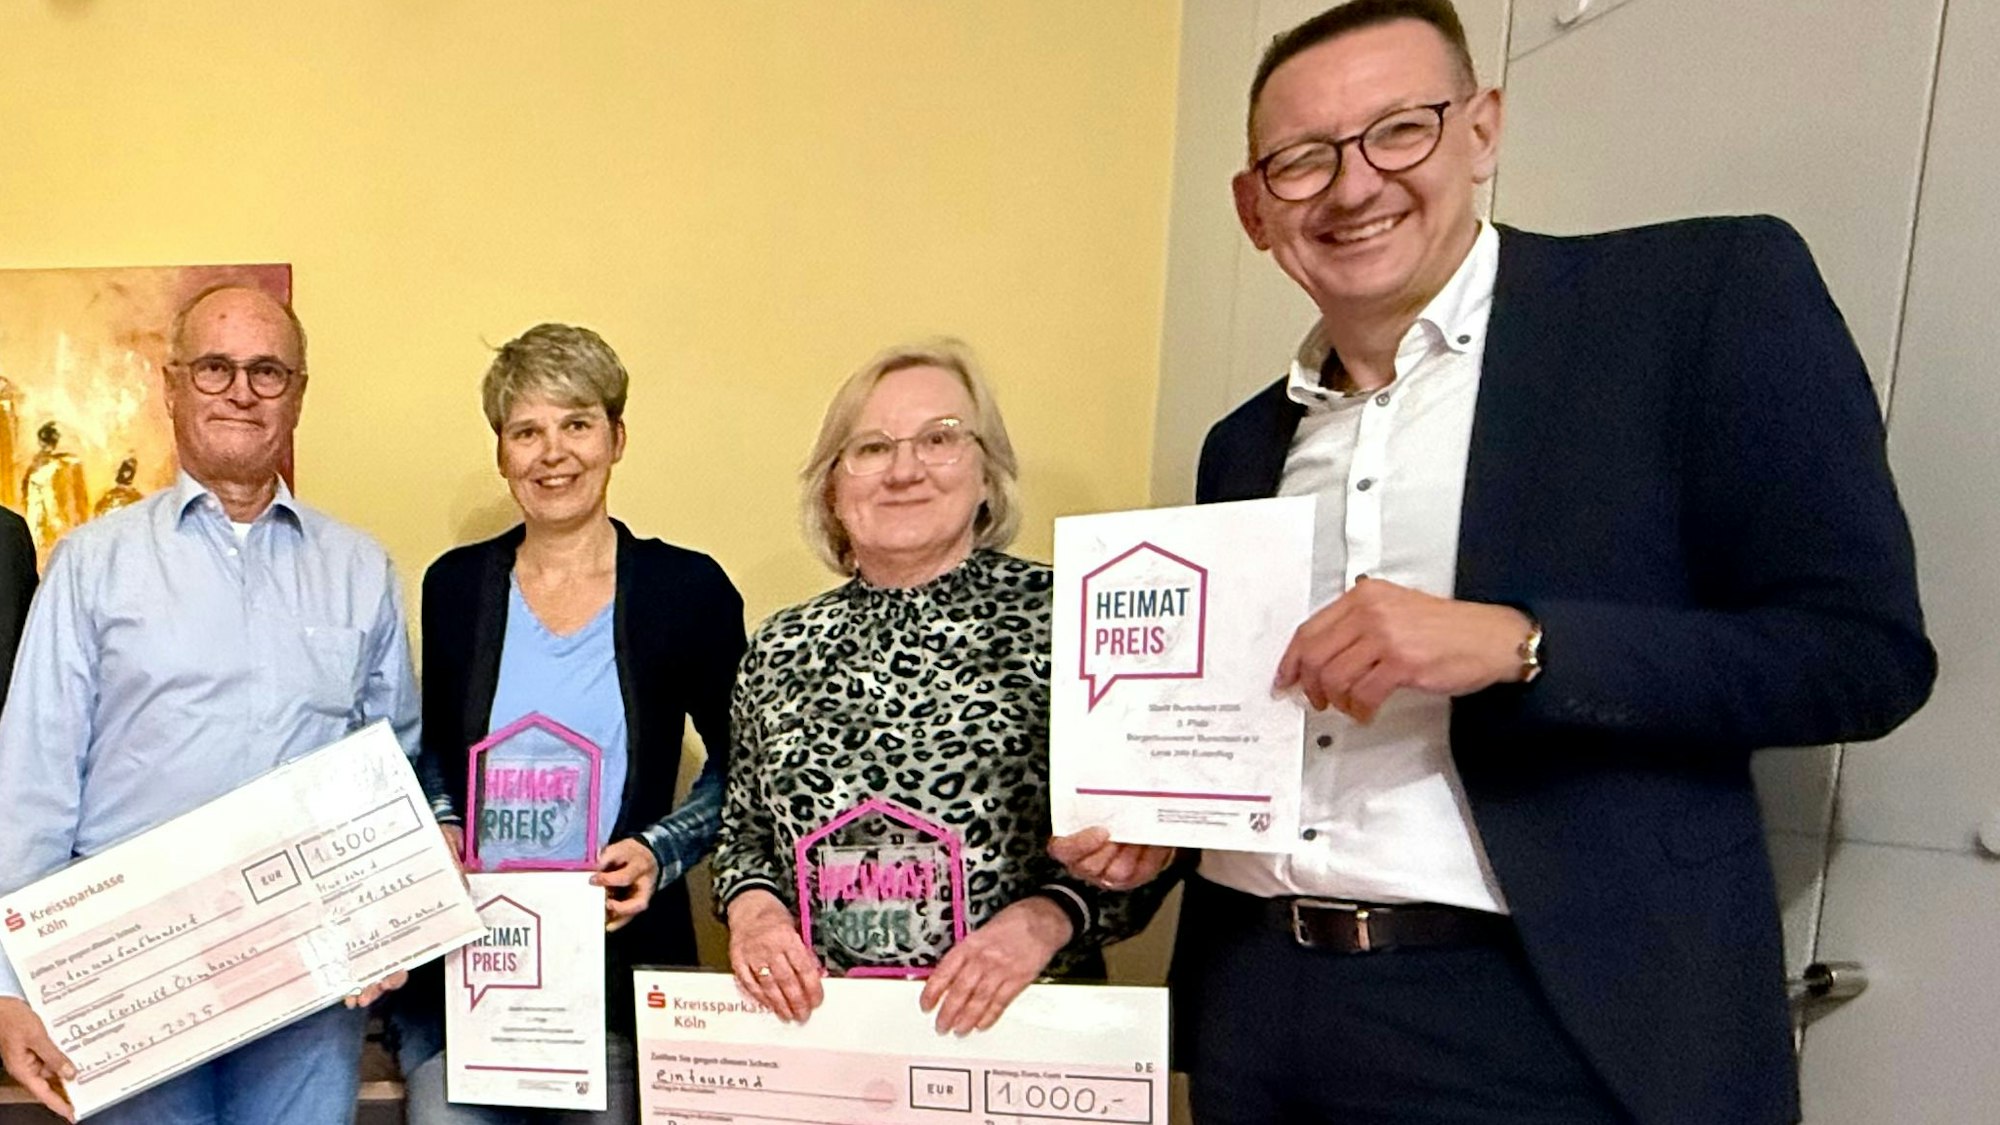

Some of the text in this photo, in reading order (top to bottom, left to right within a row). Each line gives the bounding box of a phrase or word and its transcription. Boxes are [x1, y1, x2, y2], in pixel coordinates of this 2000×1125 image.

[1096, 587, 1191, 620] HEIMAT
[1095, 626, 1165, 655] PREIS
[485, 768, 580, 800] HEIMAT
[483, 808, 556, 841] PREIS
[259, 868, 284, 886] EUR
[30, 873, 125, 922] Kreissparkasse
[37, 918, 68, 938] Köln
[472, 952, 517, 971] PREIS
[673, 998, 770, 1015] Kreissparkas
[673, 1016, 706, 1029] Köln
[1135, 1062, 1154, 1073] DE
[656, 1068, 763, 1088] eintausend
[927, 1083, 953, 1095] EUR
